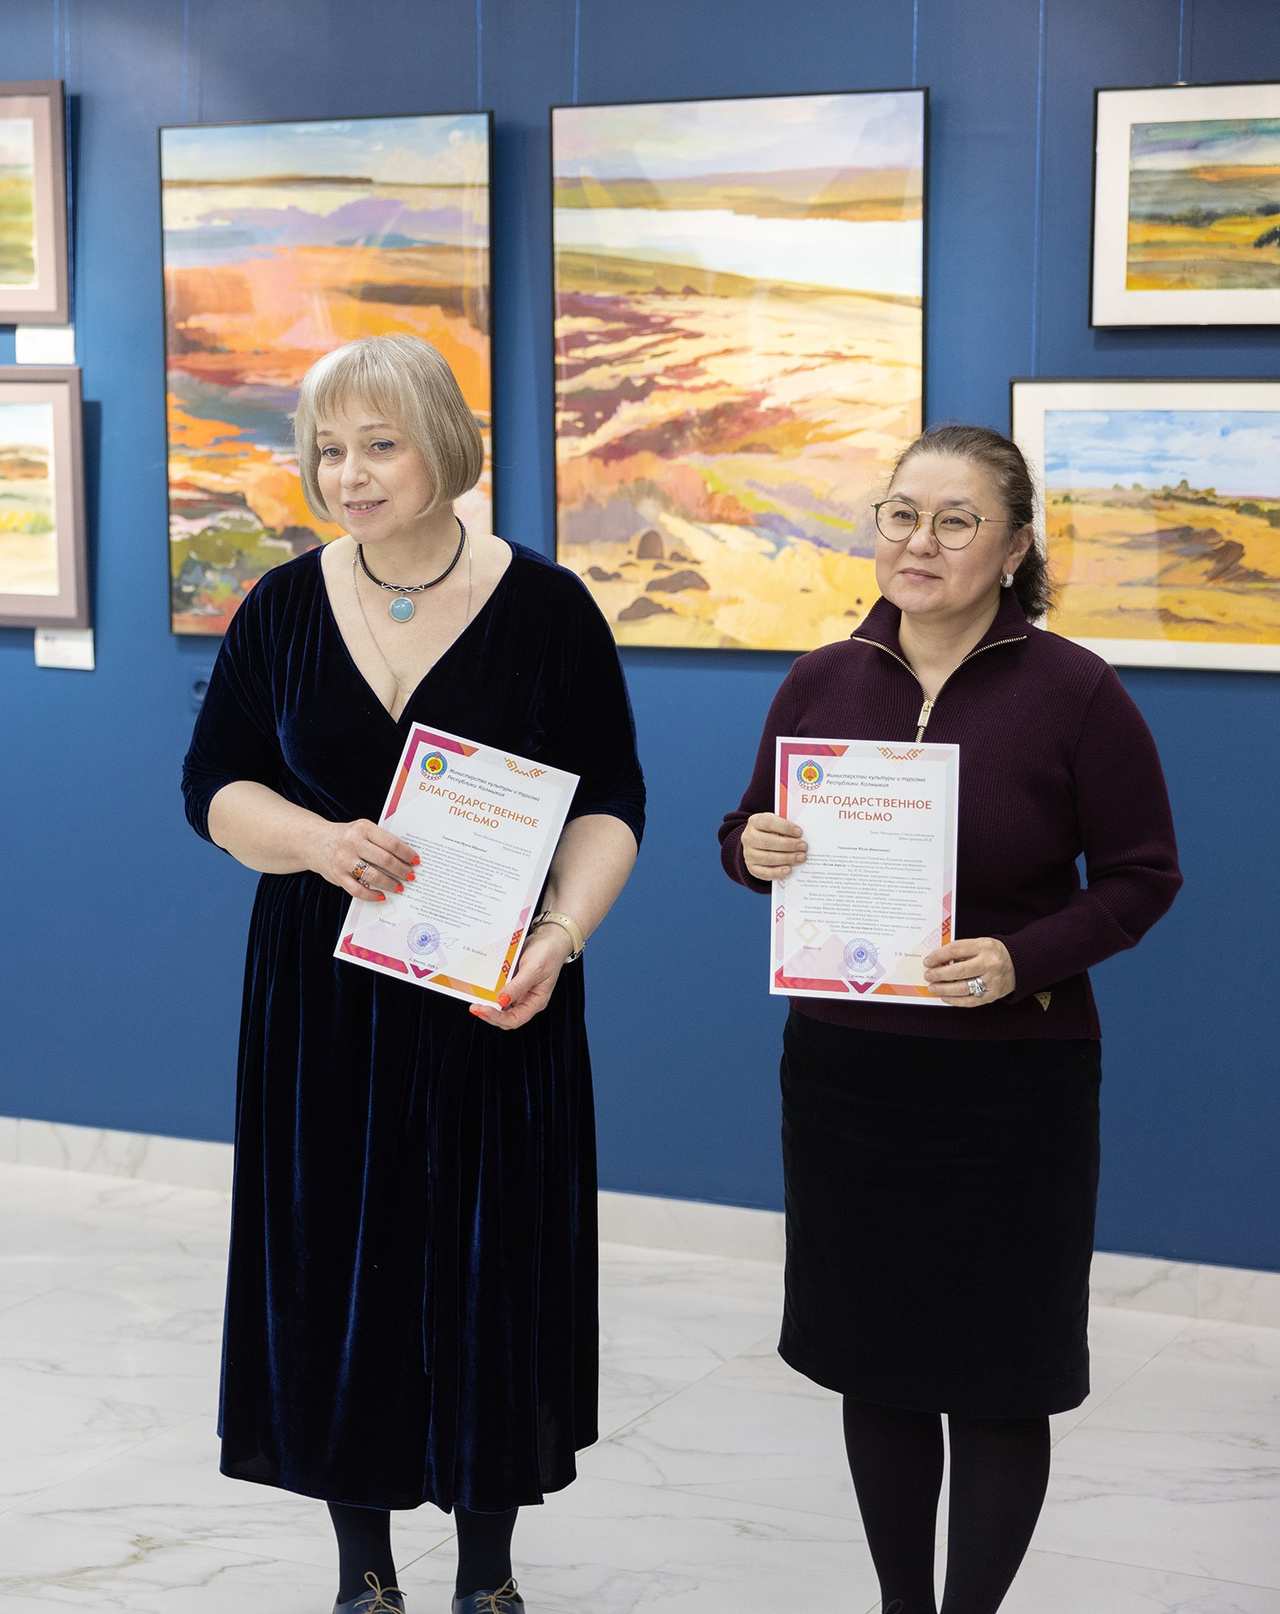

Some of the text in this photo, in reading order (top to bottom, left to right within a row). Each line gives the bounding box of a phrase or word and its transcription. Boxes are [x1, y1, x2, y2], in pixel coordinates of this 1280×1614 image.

[447, 775, 506, 797] Республики Калмыкия
[449, 769, 487, 785] Министерство
[487, 781, 513, 793] культуры
[517, 791, 541, 802] туризма
[418, 781, 540, 828] БЛАГОДАРСТВЕННОЕ
[801, 794, 932, 810] БЛАГОДАРСТВЕННОЕ
[448, 806, 499, 829] ПИСЬМО
[838, 810, 893, 822] ПИСЬМО
